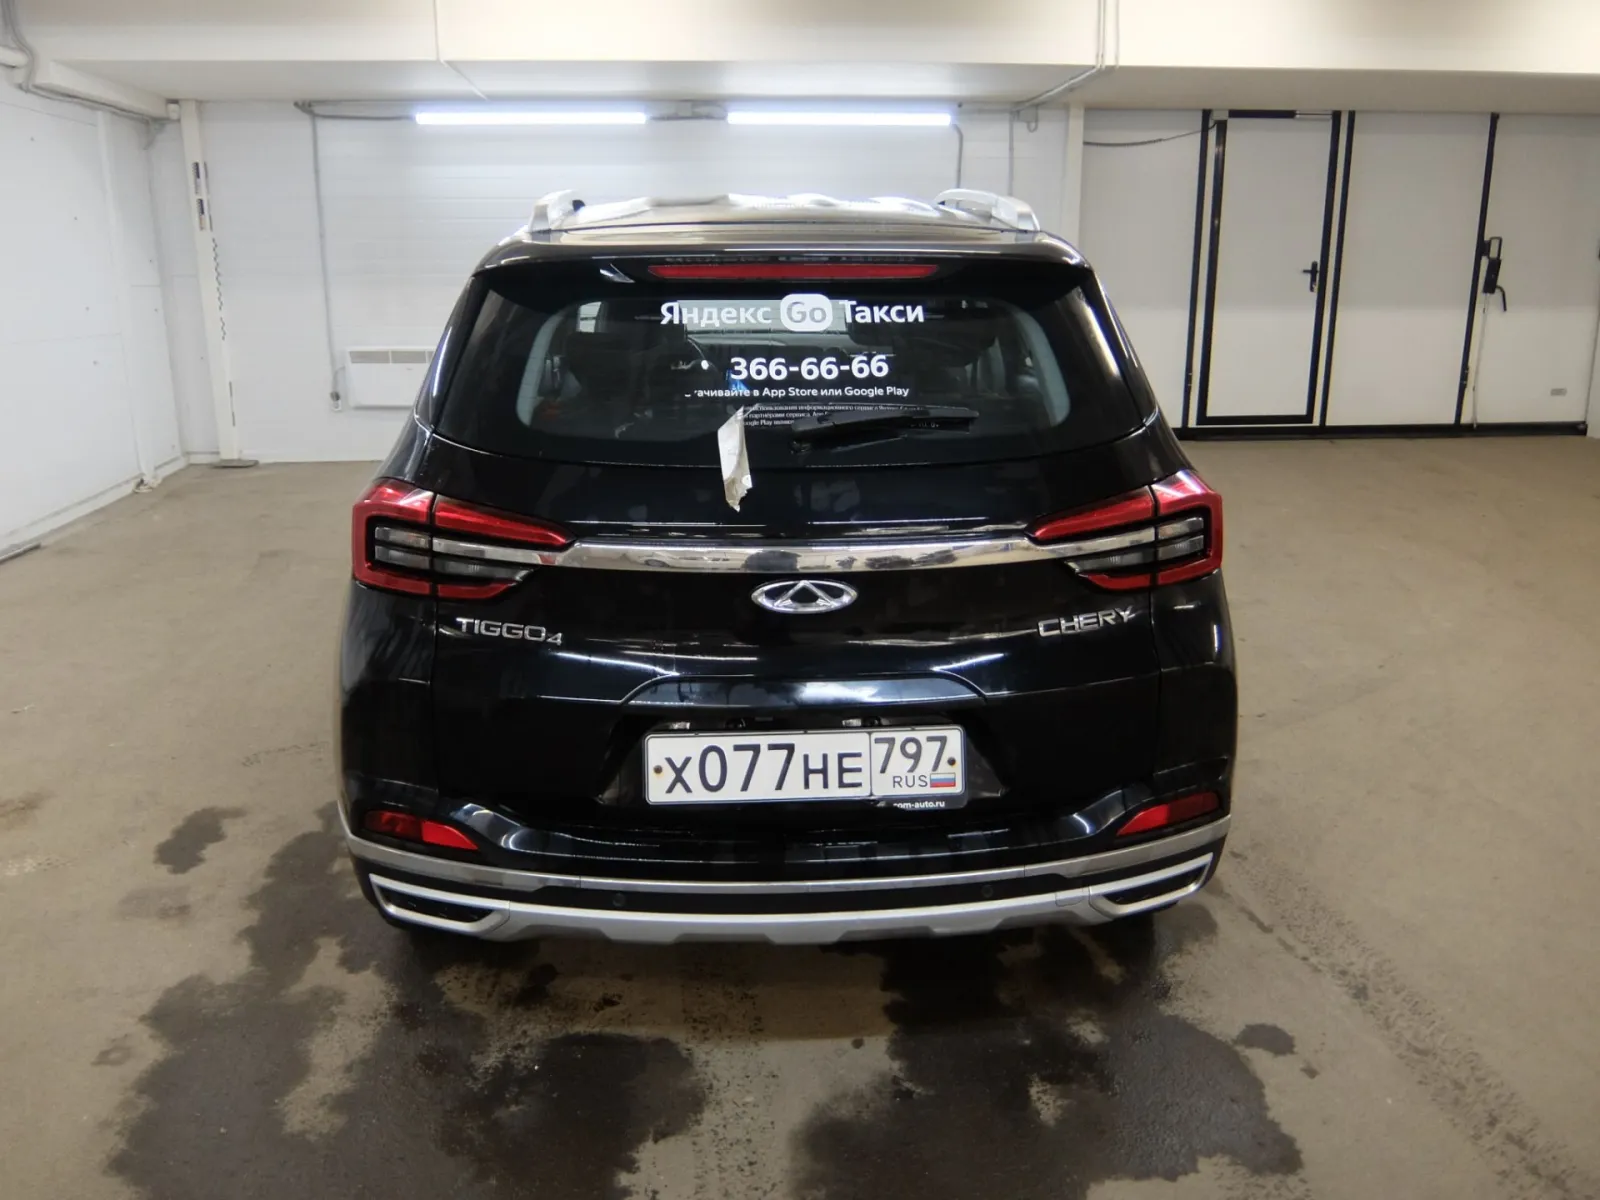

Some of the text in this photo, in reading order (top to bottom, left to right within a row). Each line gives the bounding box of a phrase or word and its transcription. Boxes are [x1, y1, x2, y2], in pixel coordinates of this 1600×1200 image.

[660, 300, 925, 327] Яндекс Go Такси
[730, 355, 889, 380] 366-66-66
[684, 386, 909, 398] ачивайте в App Store или Google Play
[1038, 605, 1134, 637] CHERY
[873, 735, 948, 775] 797
[892, 774, 928, 789] RUS
[893, 801, 946, 809] om-auto.ru
